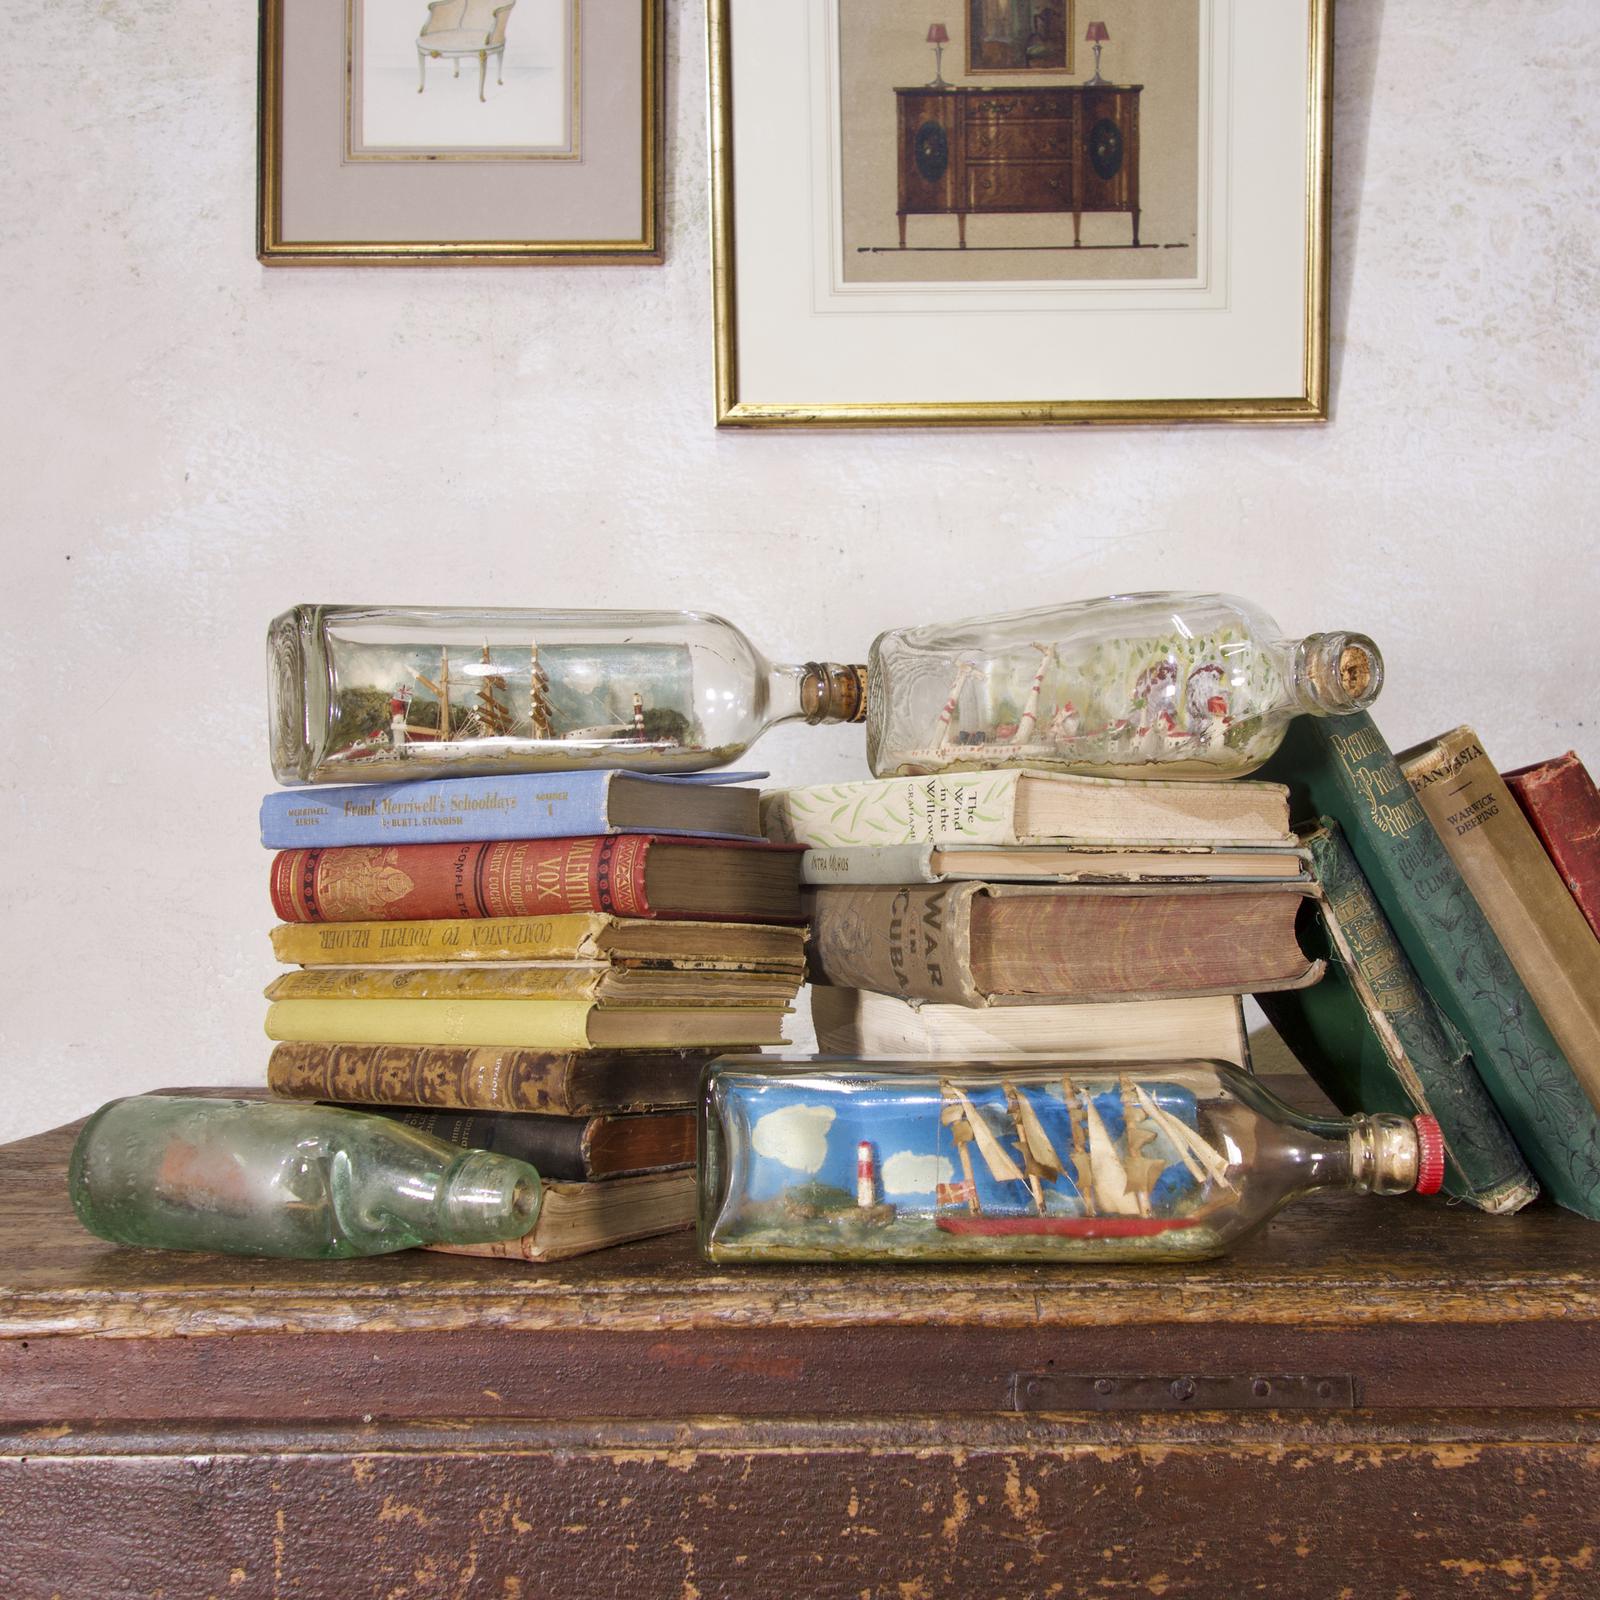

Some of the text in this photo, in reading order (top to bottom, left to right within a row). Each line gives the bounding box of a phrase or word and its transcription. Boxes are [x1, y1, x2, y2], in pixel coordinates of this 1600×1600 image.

[343, 792, 518, 818] Frank Merriwell's Schooldays
[422, 815, 464, 827] STANDISH
[926, 779, 936, 843] Willows
[940, 787, 950, 832] in the
[954, 786, 963, 831] Wind
[967, 790, 978, 824] The
[1447, 793, 1497, 825] WARWICK
[1456, 805, 1500, 836] DEEPING
[295, 817, 321, 827] SERIES
[454, 847, 470, 917] COMPLETE
[510, 843, 529, 916] VENTRILOQUIS
[525, 864, 534, 893] THE
[536, 856, 563, 900] VOX
[489, 877, 506, 916] COCKTO
[379, 927, 432, 949] FOURTH
[441, 926, 460, 947] TO
[470, 922, 553, 947] COMPANION
[889, 890, 910, 990] CUBA
[923, 890, 948, 987] WAR
[451, 1120, 463, 1145] HIRD
[461, 1117, 475, 1148] DITION
